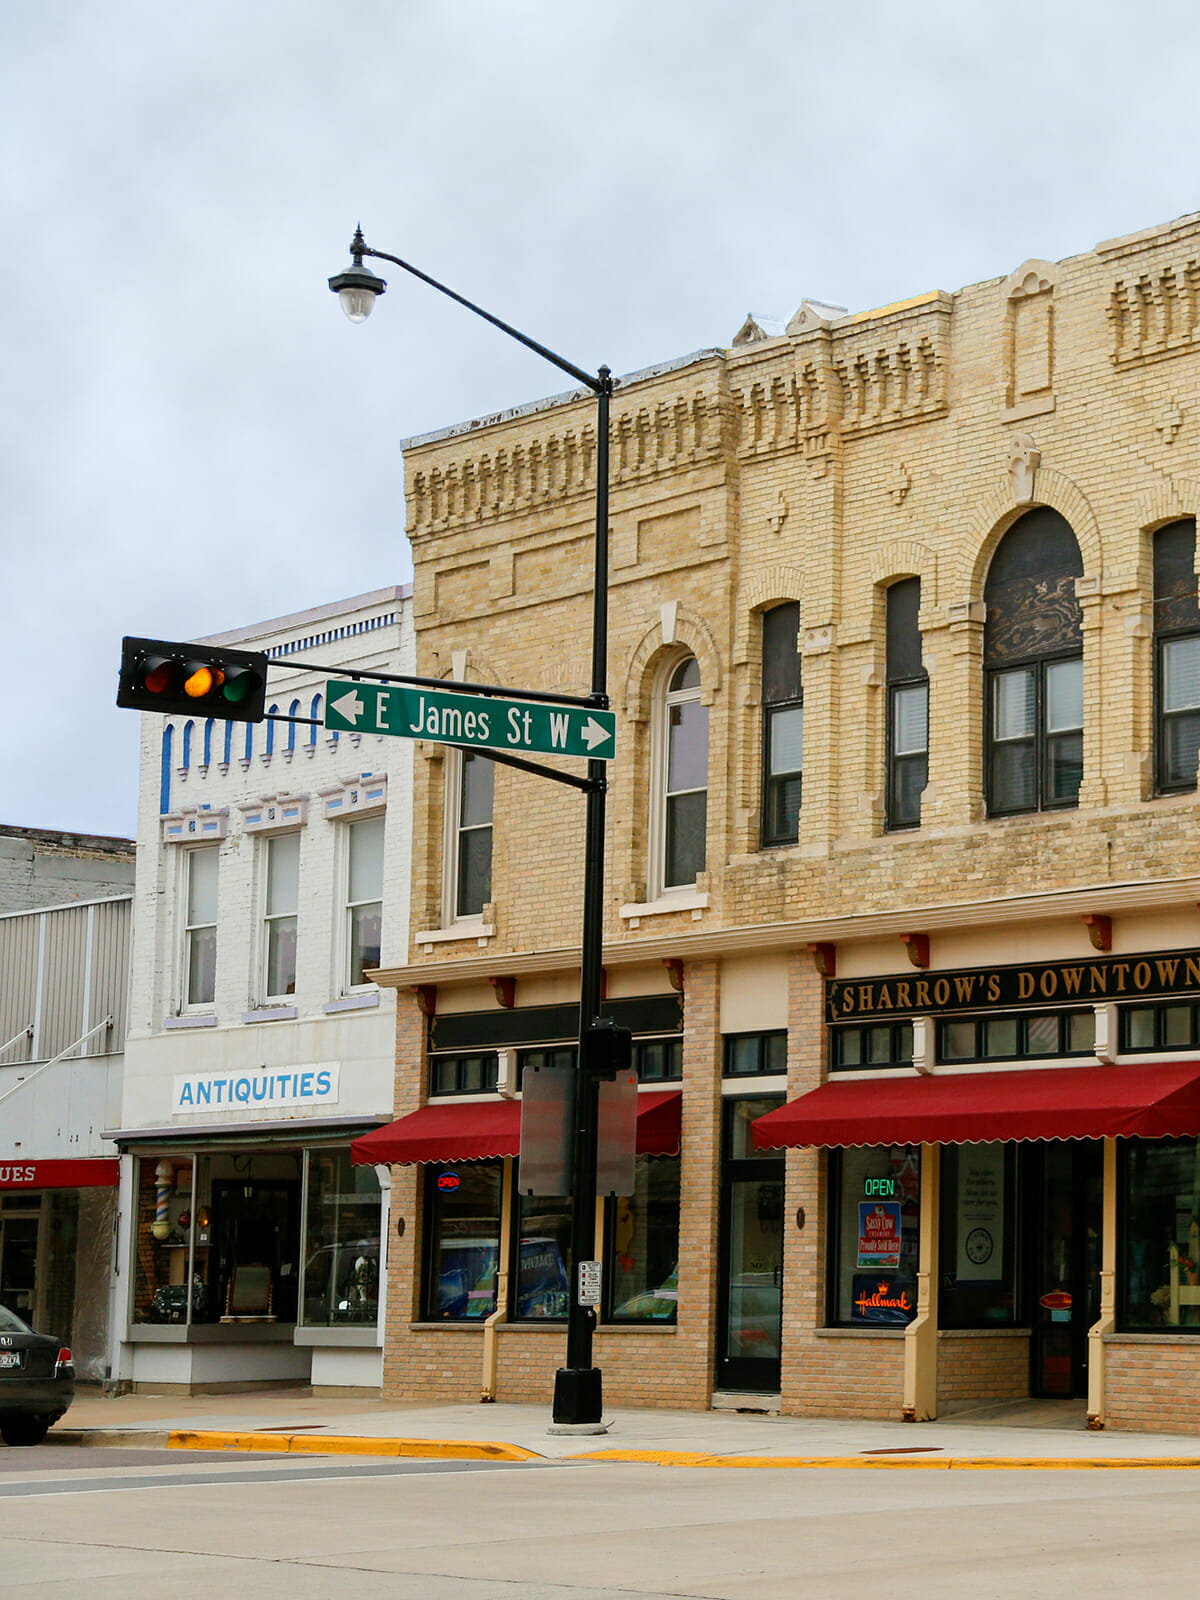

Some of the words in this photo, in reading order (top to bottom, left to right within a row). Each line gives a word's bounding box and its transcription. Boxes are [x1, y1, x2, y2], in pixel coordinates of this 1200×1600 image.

[376, 692, 390, 729] E
[410, 697, 490, 740] James
[507, 707, 532, 745] St
[550, 712, 569, 748] W
[842, 974, 1001, 1013] SHARROW'S
[179, 1071, 331, 1105] ANTIQUITIES
[437, 1176, 460, 1188] OPEN
[864, 1178, 895, 1196] OPEN
[854, 1290, 912, 1316] Hallmark
